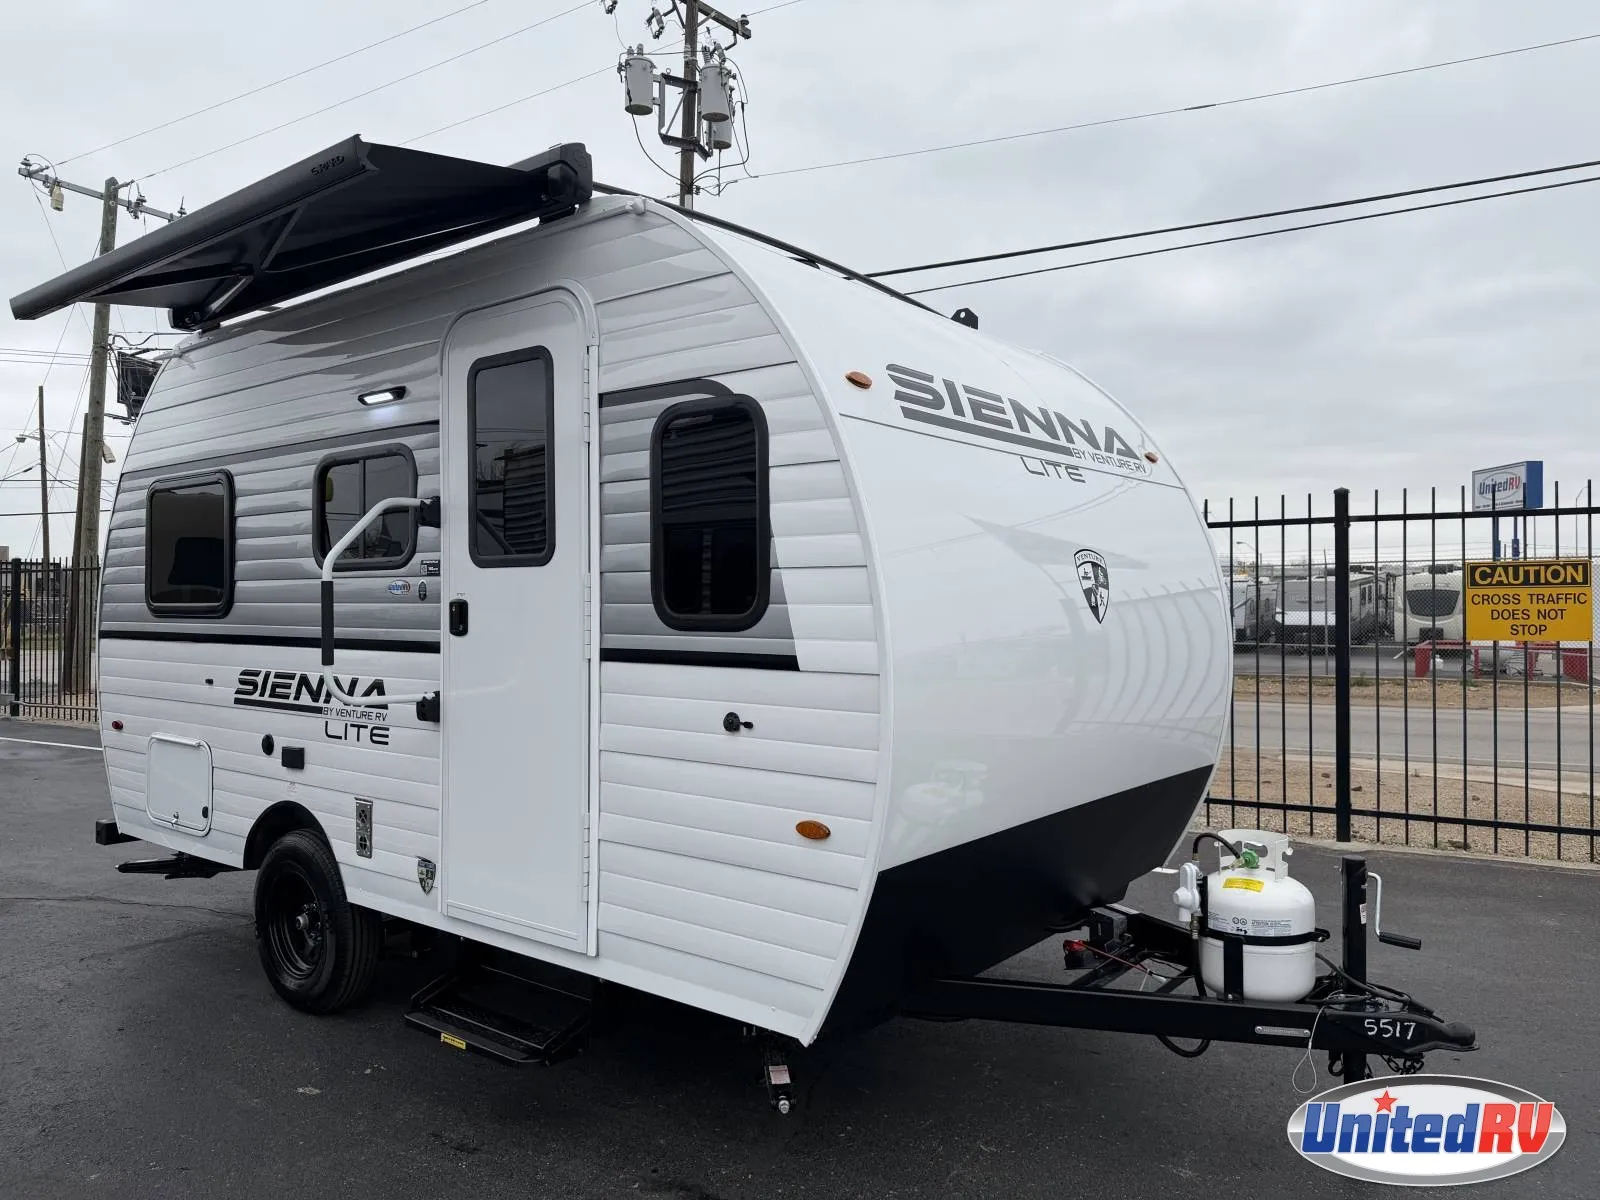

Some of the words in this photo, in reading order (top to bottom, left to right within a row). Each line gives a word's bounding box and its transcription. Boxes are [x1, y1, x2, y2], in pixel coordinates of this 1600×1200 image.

[886, 363, 1141, 461] SIENNA
[1019, 456, 1087, 484] LITE
[1072, 447, 1087, 460] BY
[1087, 451, 1134, 471] VENTURE
[1133, 462, 1147, 475] RV
[1474, 564, 1584, 585] CAUTION
[1471, 593, 1521, 606] CROSS
[1527, 592, 1588, 605] TRAFFIC
[1490, 608, 1530, 621] DOES
[1537, 608, 1567, 621] NOT
[1510, 624, 1548, 637] STOP
[323, 706, 334, 716] BY
[335, 708, 374, 721] VENTURE
[375, 712, 388, 721] RV
[324, 720, 390, 746] LITE
[1364, 1018, 1417, 1041] 5517
